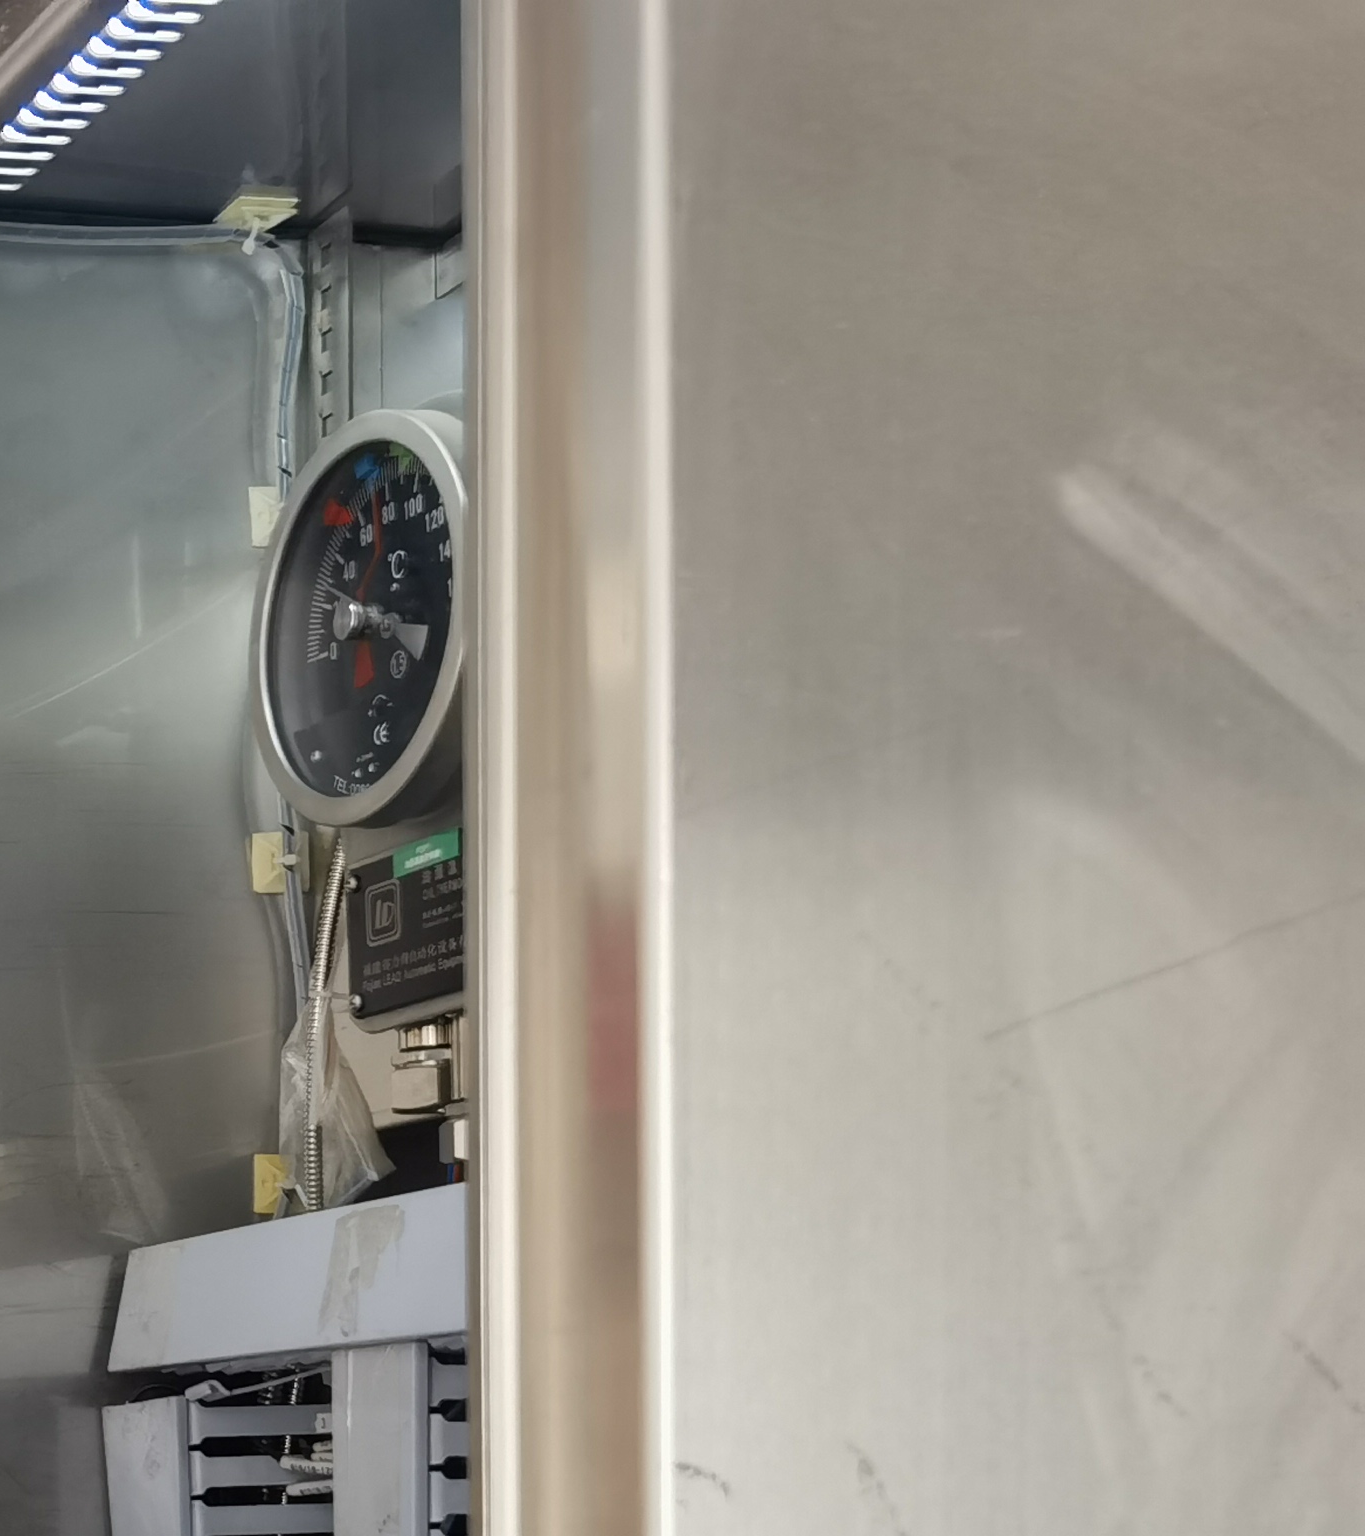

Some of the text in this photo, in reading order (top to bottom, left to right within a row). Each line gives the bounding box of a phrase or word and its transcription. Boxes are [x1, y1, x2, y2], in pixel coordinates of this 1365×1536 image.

[381, 501, 395, 525] 80
[404, 493, 423, 520] 100
[425, 505, 444, 533] 120
[359, 523, 373, 547] 60
[438, 539, 451, 562] 14
[342, 559, 356, 582] 40
